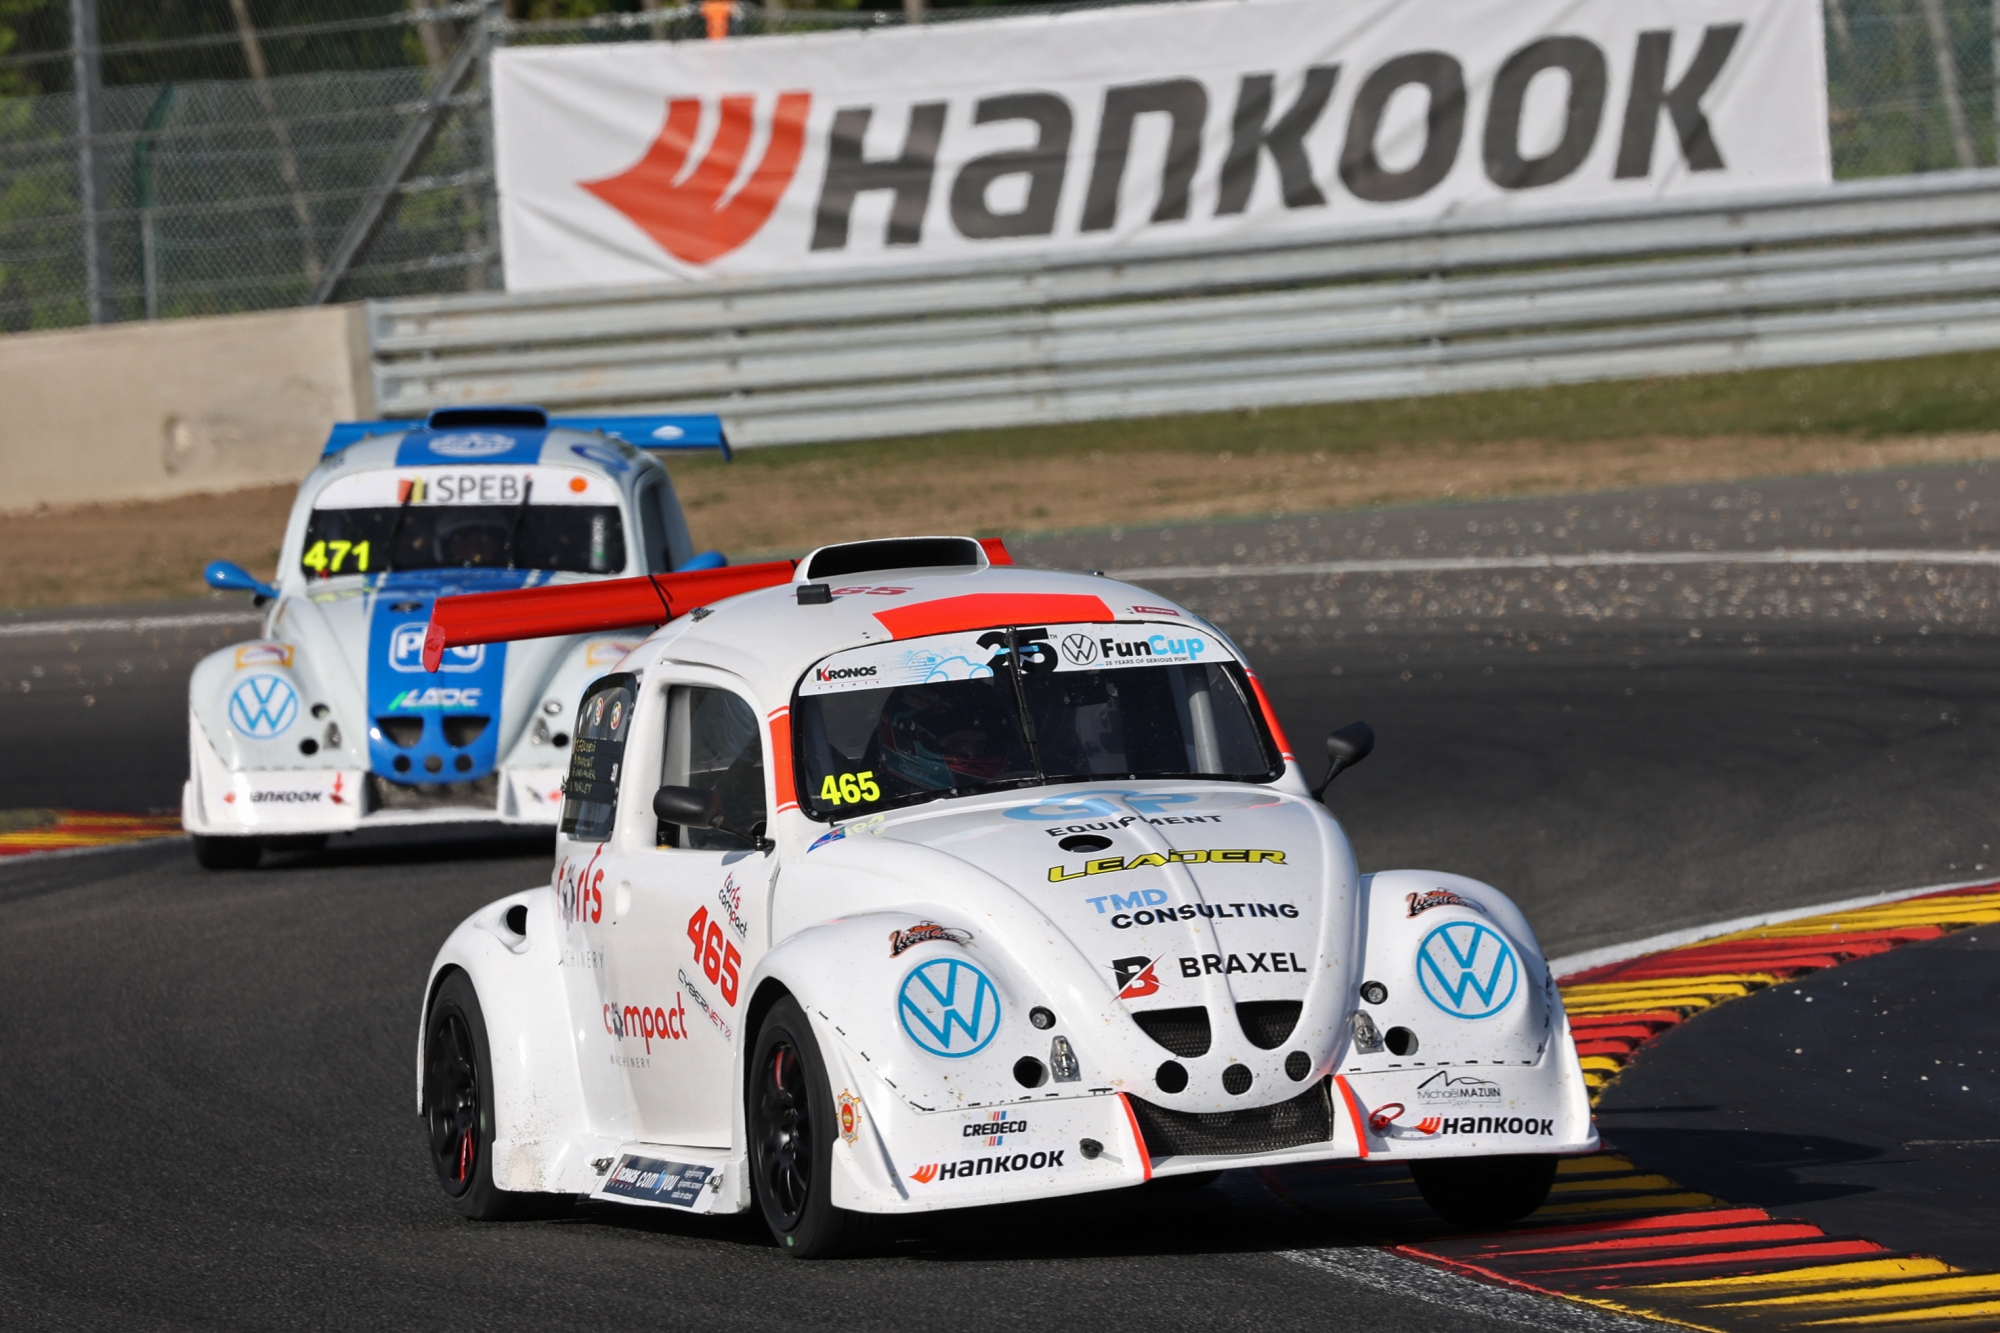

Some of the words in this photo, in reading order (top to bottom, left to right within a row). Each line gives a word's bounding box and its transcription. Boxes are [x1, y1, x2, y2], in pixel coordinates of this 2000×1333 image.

[437, 474, 518, 501] SPEB
[303, 540, 370, 572] 471
[1100, 634, 1204, 661] FunCup
[816, 663, 878, 682] KRONOS
[821, 770, 880, 806] 465
[1002, 789, 1199, 821] GP
[1045, 815, 1222, 837] EQUIPMENT
[1047, 849, 1289, 882] LEADER
[1085, 888, 1168, 915] TMD
[1110, 903, 1300, 929] CONSULTING
[687, 905, 742, 1008] 465
[1178, 952, 1307, 978] BRAXEL
[962, 1120, 1027, 1137] CREDECO
